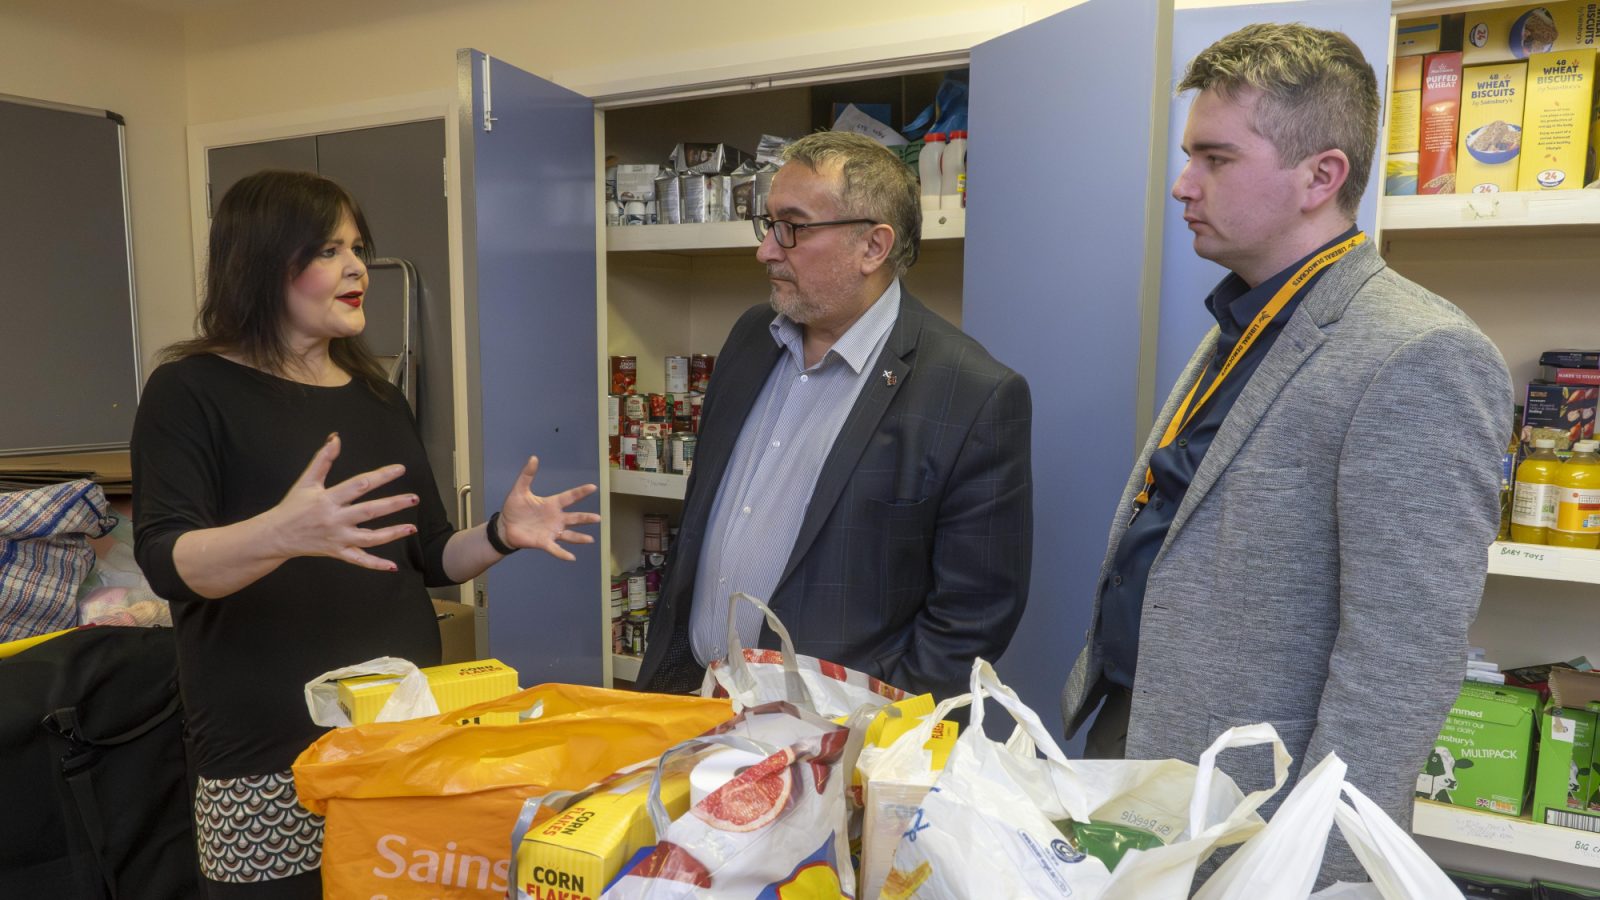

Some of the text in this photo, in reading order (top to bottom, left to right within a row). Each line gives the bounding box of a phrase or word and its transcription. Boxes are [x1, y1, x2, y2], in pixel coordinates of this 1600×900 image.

[1585, 4, 1596, 44] BISCUITS
[1476, 28, 1487, 41] 24
[1543, 65, 1579, 75] WHEAT
[1426, 74, 1458, 83] PUFFED
[1537, 74, 1583, 84] BISCUITS
[1427, 81, 1456, 90] WHEAT
[1477, 80, 1510, 89] WHEAT
[1471, 88, 1515, 98] BISCUITS
[1544, 172, 1557, 180] 24
[1479, 185, 1492, 193] 24
[1292, 246, 1347, 286] LIBERAL DEMOCRATS
[1242, 324, 1260, 346] LIBERAL
[1500, 547, 1544, 561] BABY TOYS
[459, 667, 503, 676] FLAKES
[1461, 748, 1517, 759] MULTIPACK
[542, 807, 586, 836] FLAKES
[560, 811, 595, 835] CORN
[1574, 840, 1590, 851] BIG
[533, 866, 584, 893] CORN
[526, 883, 592, 900] FLAK
